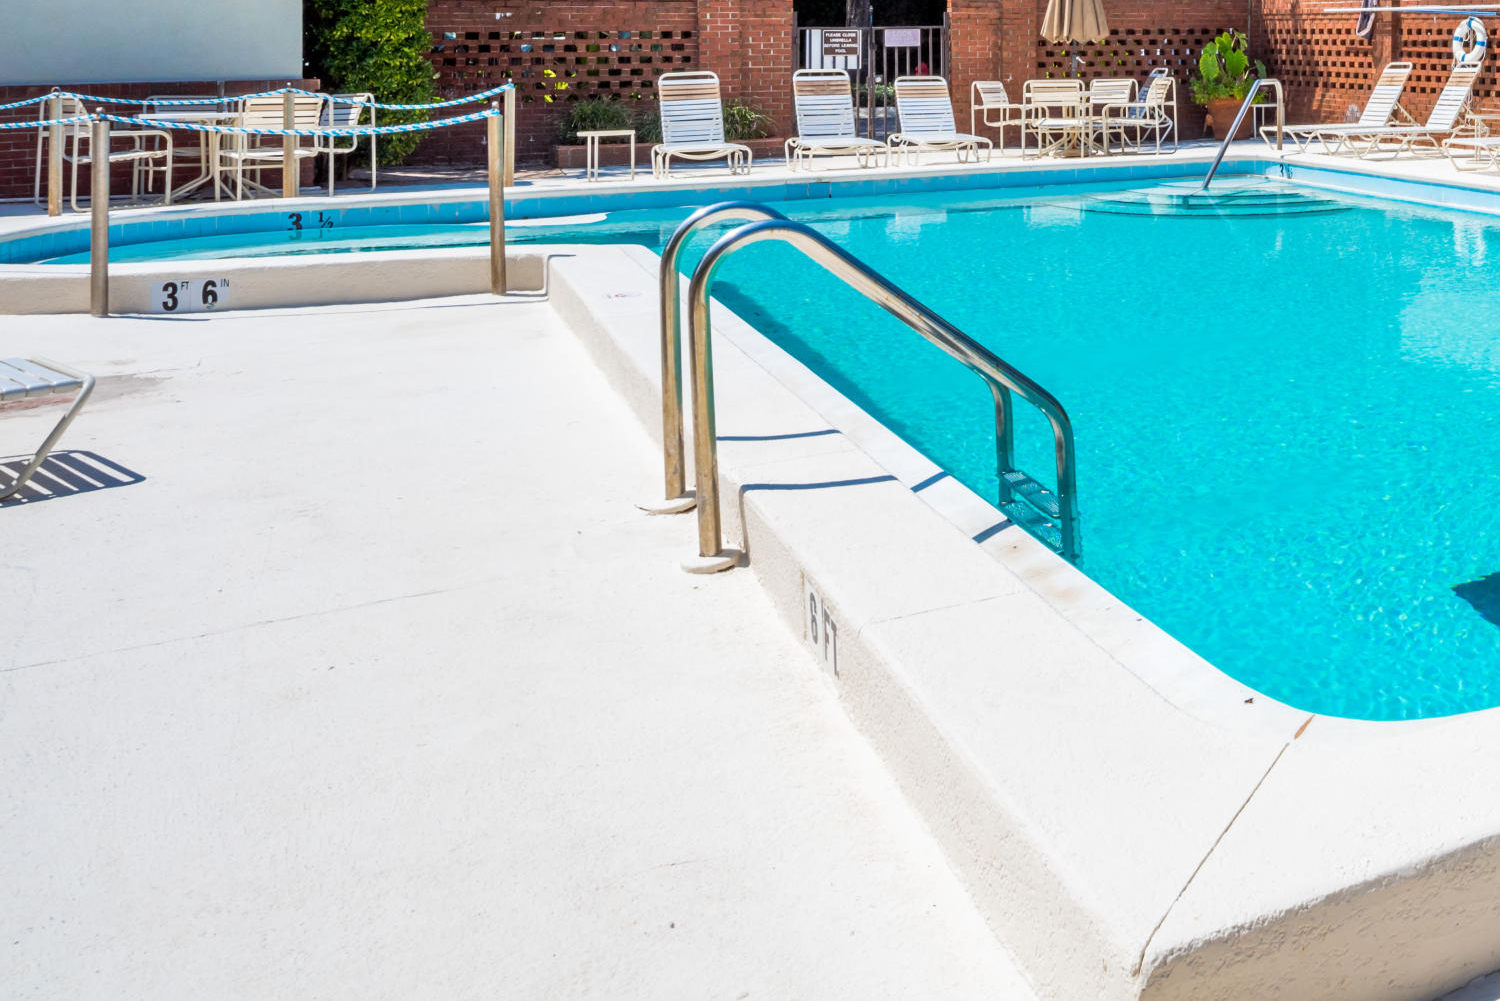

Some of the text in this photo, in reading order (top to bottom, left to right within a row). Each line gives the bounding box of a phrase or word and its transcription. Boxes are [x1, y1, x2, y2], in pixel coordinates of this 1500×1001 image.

[287, 213, 303, 230] 3
[162, 279, 230, 312] 3 FT 6 IN
[809, 592, 838, 676] 6 FT
